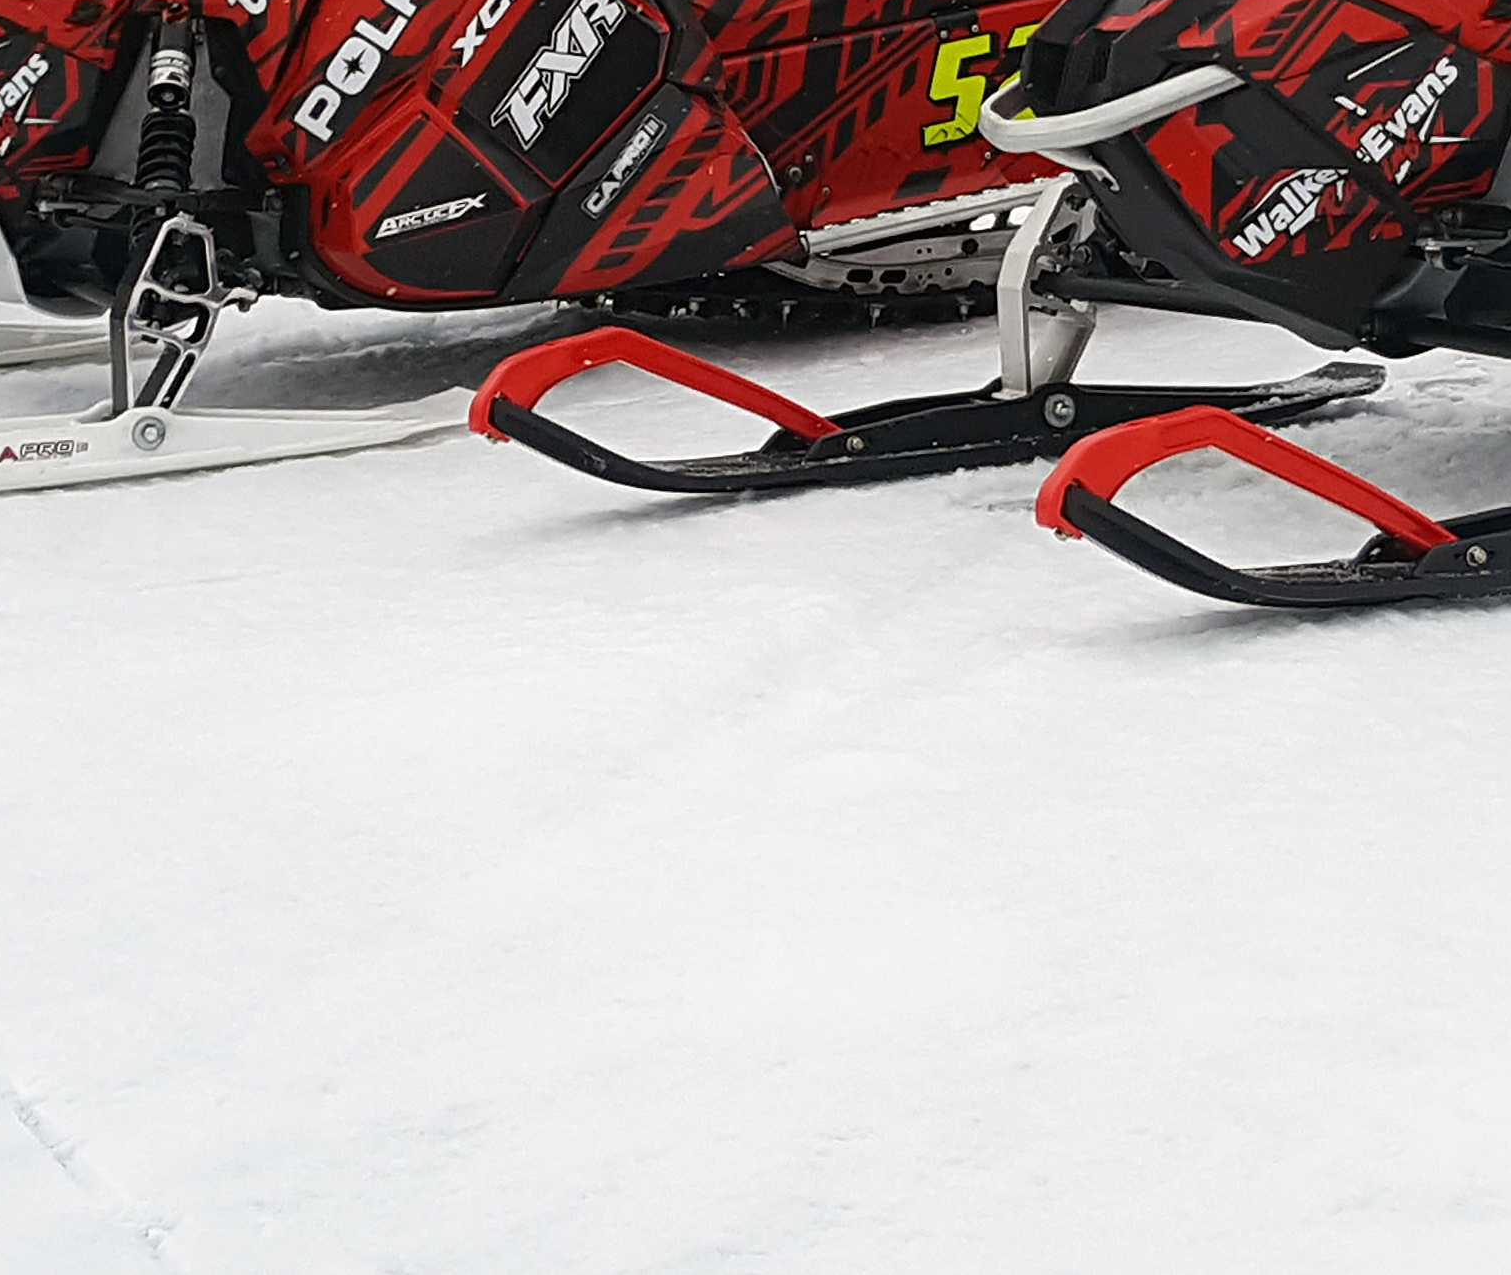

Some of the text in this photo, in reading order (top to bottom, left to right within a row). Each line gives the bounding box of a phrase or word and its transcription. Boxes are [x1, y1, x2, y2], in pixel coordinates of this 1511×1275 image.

[923, 23, 1040, 146] 5
[1232, 166, 1348, 258] Walke
[1358, 56, 1459, 163] Evans
